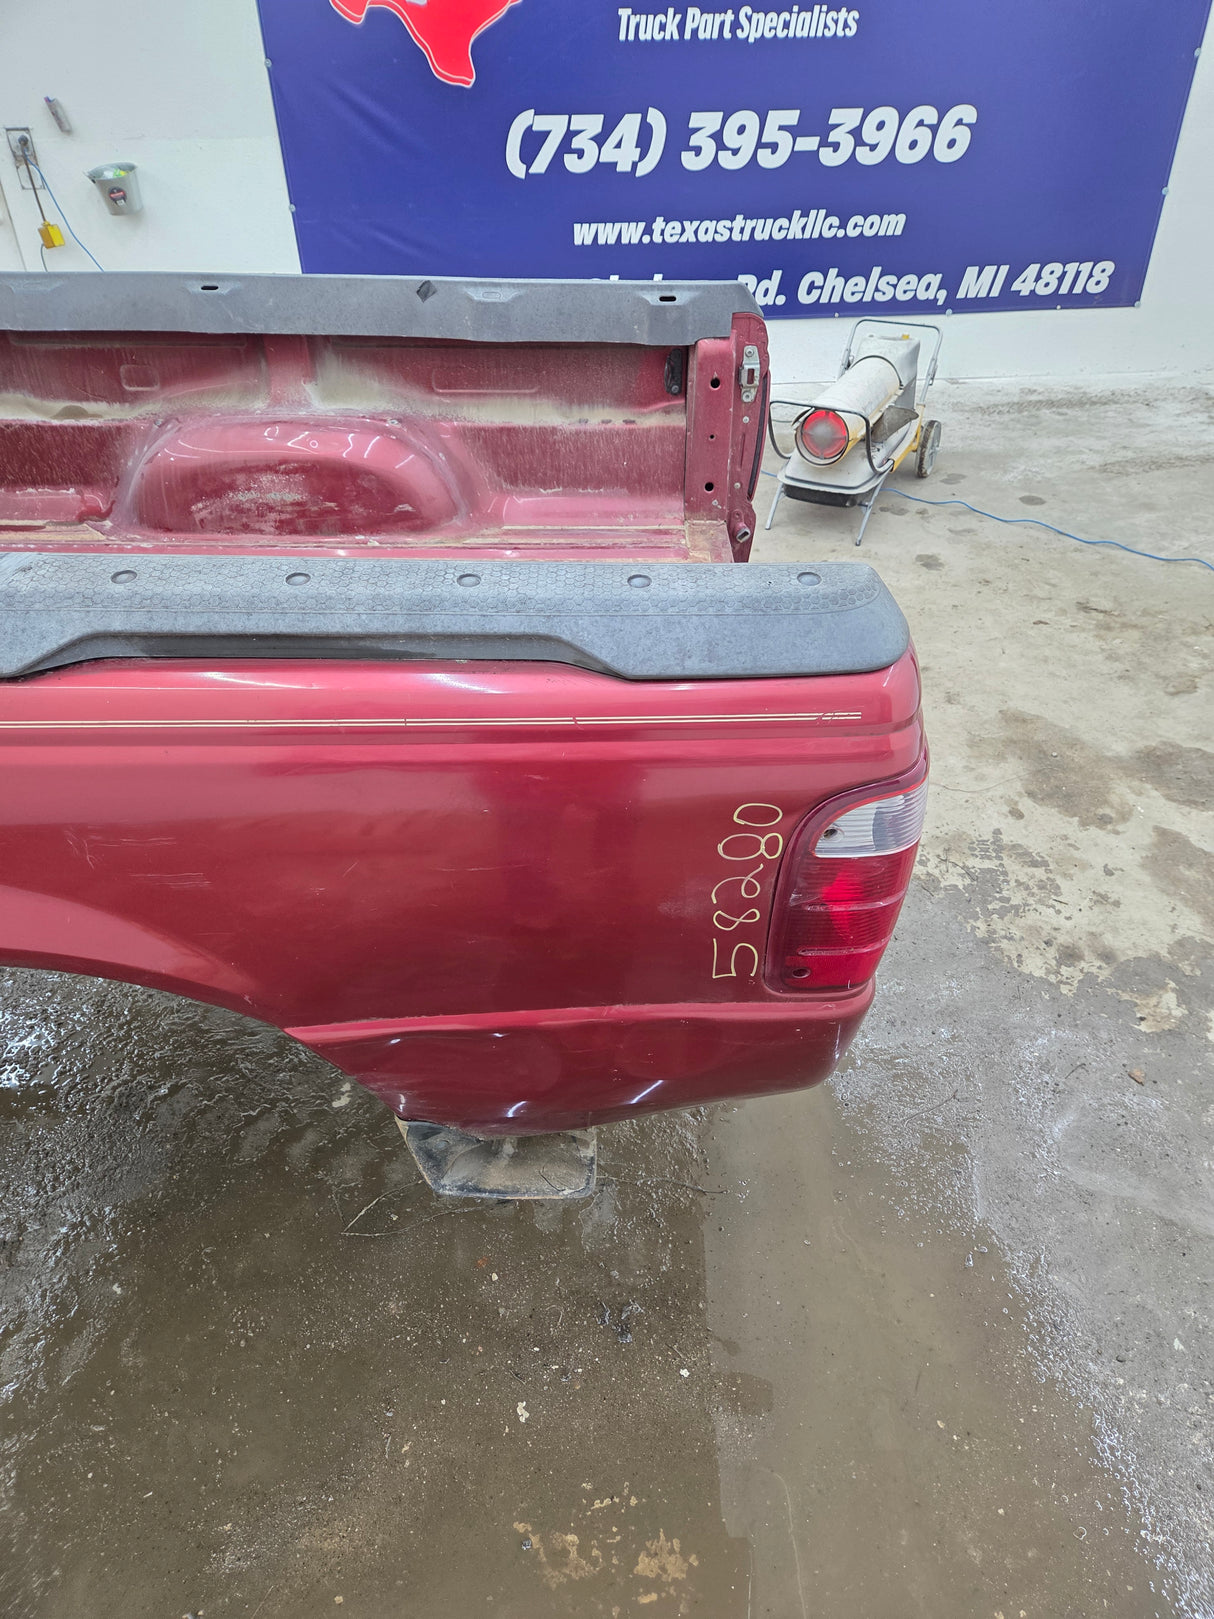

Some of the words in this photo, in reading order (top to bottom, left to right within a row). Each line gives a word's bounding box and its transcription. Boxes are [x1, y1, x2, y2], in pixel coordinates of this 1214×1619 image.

[618, 8, 682, 41] Truck
[684, 7, 734, 41] Part
[736, 5, 860, 43] Specialists
[505, 108, 667, 180] (734)
[680, 103, 978, 171] 395-3966
[573, 209, 907, 246] www.texastruckllc.com
[797, 266, 948, 306] Chelsea,
[955, 264, 1010, 299] MI
[1010, 260, 1116, 297] 48118
[711, 803, 783, 979] 58280
